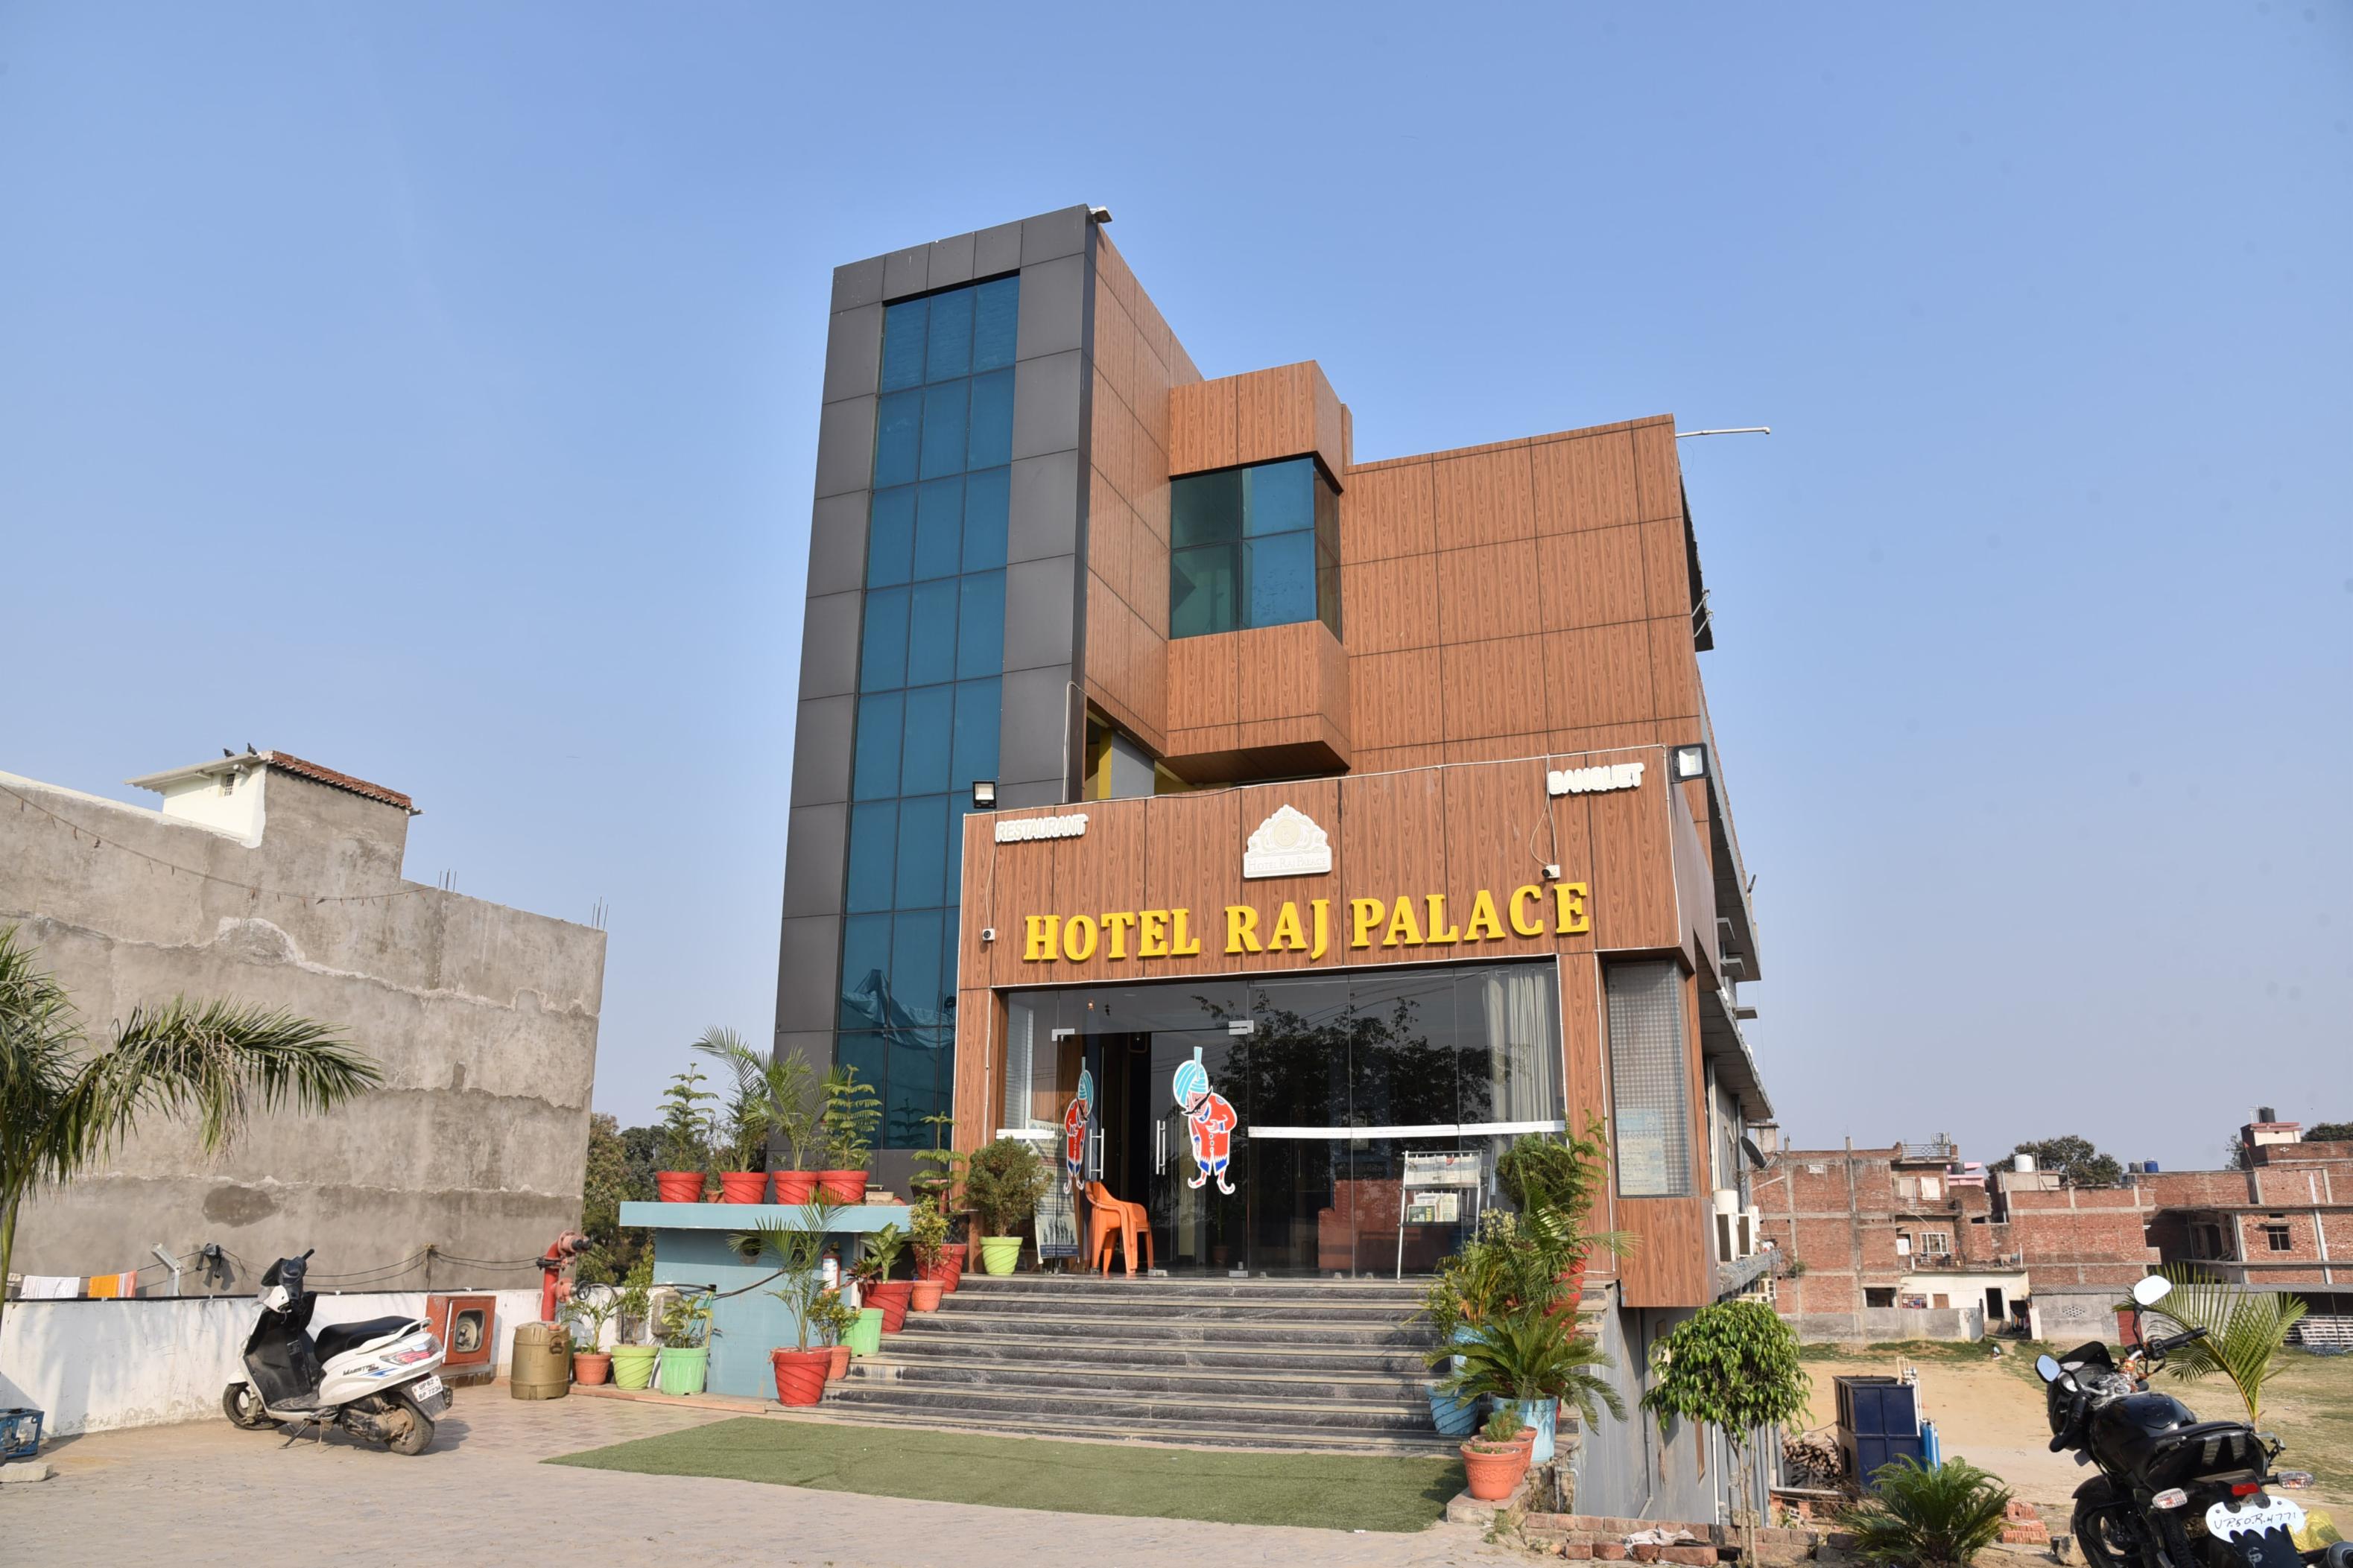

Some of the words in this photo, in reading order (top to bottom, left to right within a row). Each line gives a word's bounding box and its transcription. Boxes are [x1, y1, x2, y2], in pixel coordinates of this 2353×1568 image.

[1548, 763, 1644, 795] BANQUET
[995, 813, 1089, 842] RESTAURANT
[1023, 908, 1200, 961] HOTEL
[1224, 899, 1330, 959] RAJ
[1351, 882, 1590, 948] PALACE
